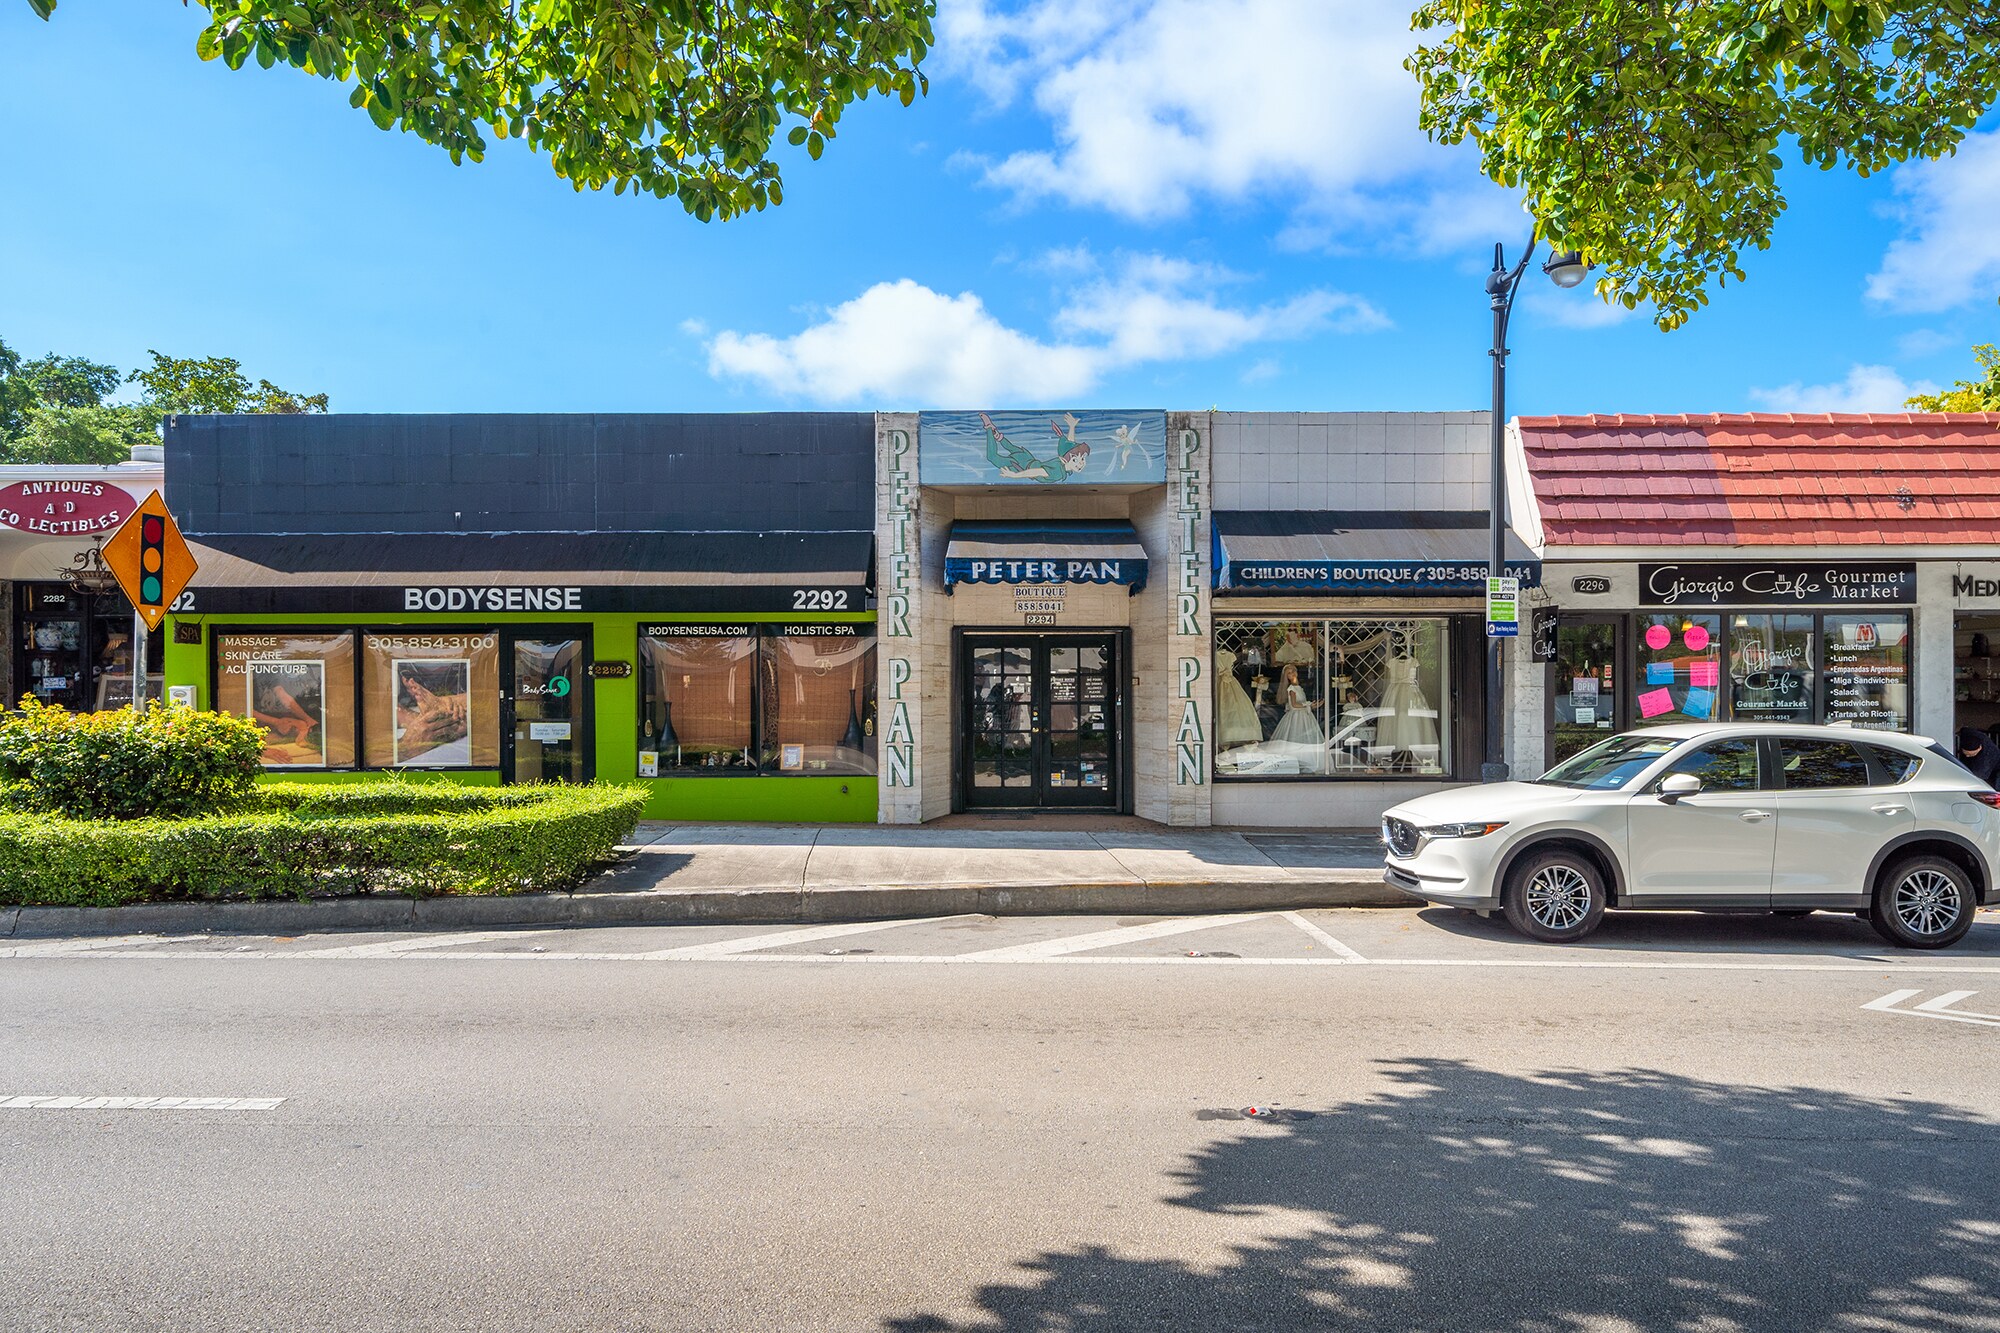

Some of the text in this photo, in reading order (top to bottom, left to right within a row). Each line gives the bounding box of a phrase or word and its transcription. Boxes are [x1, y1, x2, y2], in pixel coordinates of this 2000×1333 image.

[22, 481, 104, 496] ANTIQUES
[971, 561, 1120, 579] PETER PAN
[1241, 567, 1328, 580] CHILDREN'S
[1333, 568, 1411, 583] BOUTIQUE
[1825, 570, 1905, 584] Gourmet
[1580, 580, 1604, 591] 2296
[1649, 566, 1734, 604] Giorgio
[1015, 588, 1065, 598] BOUTIQUE
[1832, 585, 1899, 599] Market
[404, 588, 582, 610] BODYSENSE
[793, 590, 848, 610] 2292
[886, 429, 914, 787] PETER PAN
[1176, 429, 1204, 785] PETER PAN
[1028, 615, 1052, 624] 2294
[180, 627, 199, 640] SPA
[648, 626, 748, 635] BODYSENSEUSA.COM
[784, 626, 855, 635] HOLISTIC SPA
[225, 638, 277, 646] MASSAGE
[367, 637, 494, 649] 305-854-3100
[1834, 643, 1870, 651] Breakfast
[225, 652, 282, 660] SKIN CARE
[226, 665, 307, 674] ACUPUNCTURE
[1577, 682, 1596, 691] OPEN
[1834, 677, 1899, 686] Miga Sandwiches
